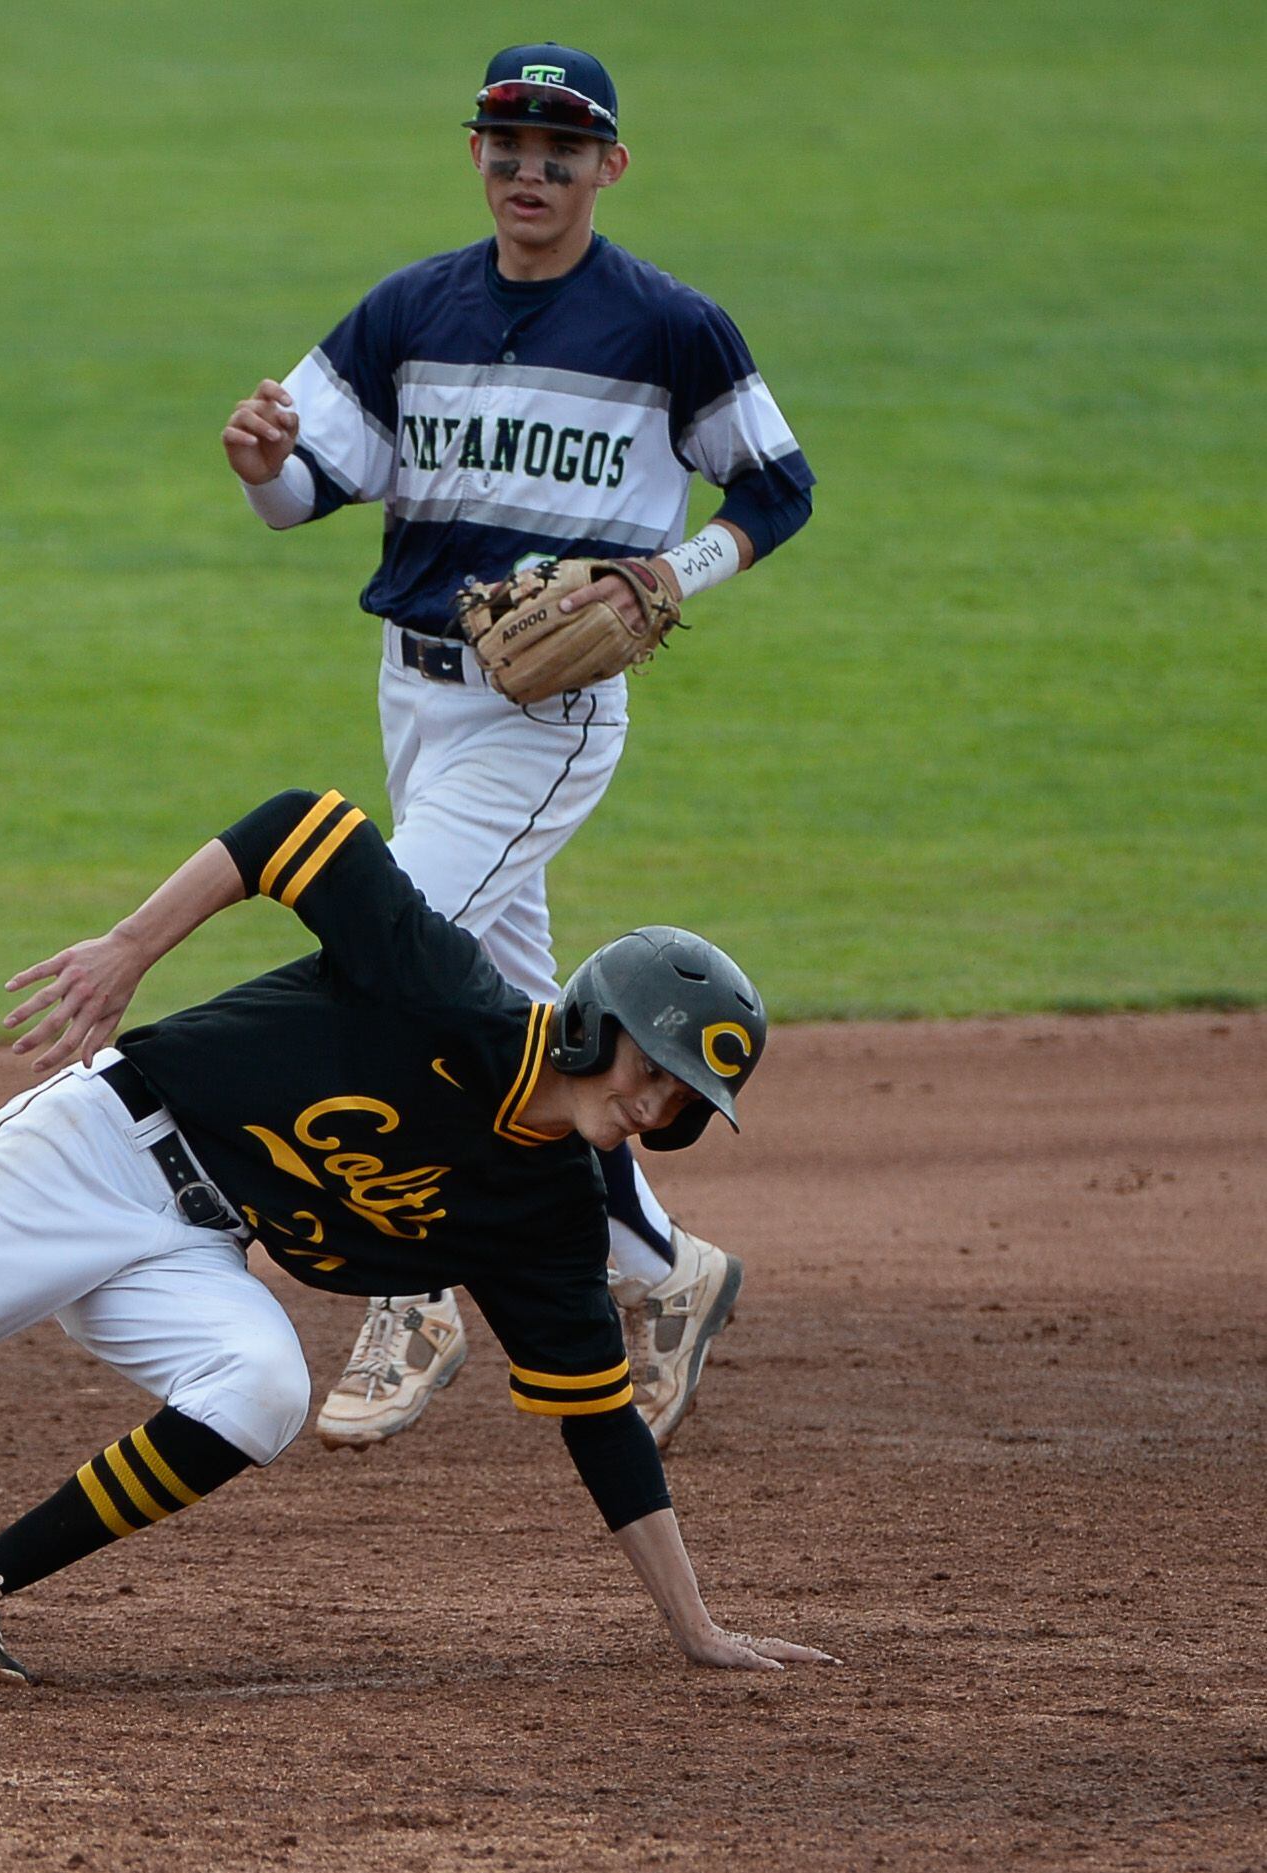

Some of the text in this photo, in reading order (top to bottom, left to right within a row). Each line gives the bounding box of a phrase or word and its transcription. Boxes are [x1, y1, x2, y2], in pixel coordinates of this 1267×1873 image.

[682, 540, 723, 577] ALMA
[501, 608, 548, 645] A2000
[701, 1021, 752, 1078] C
